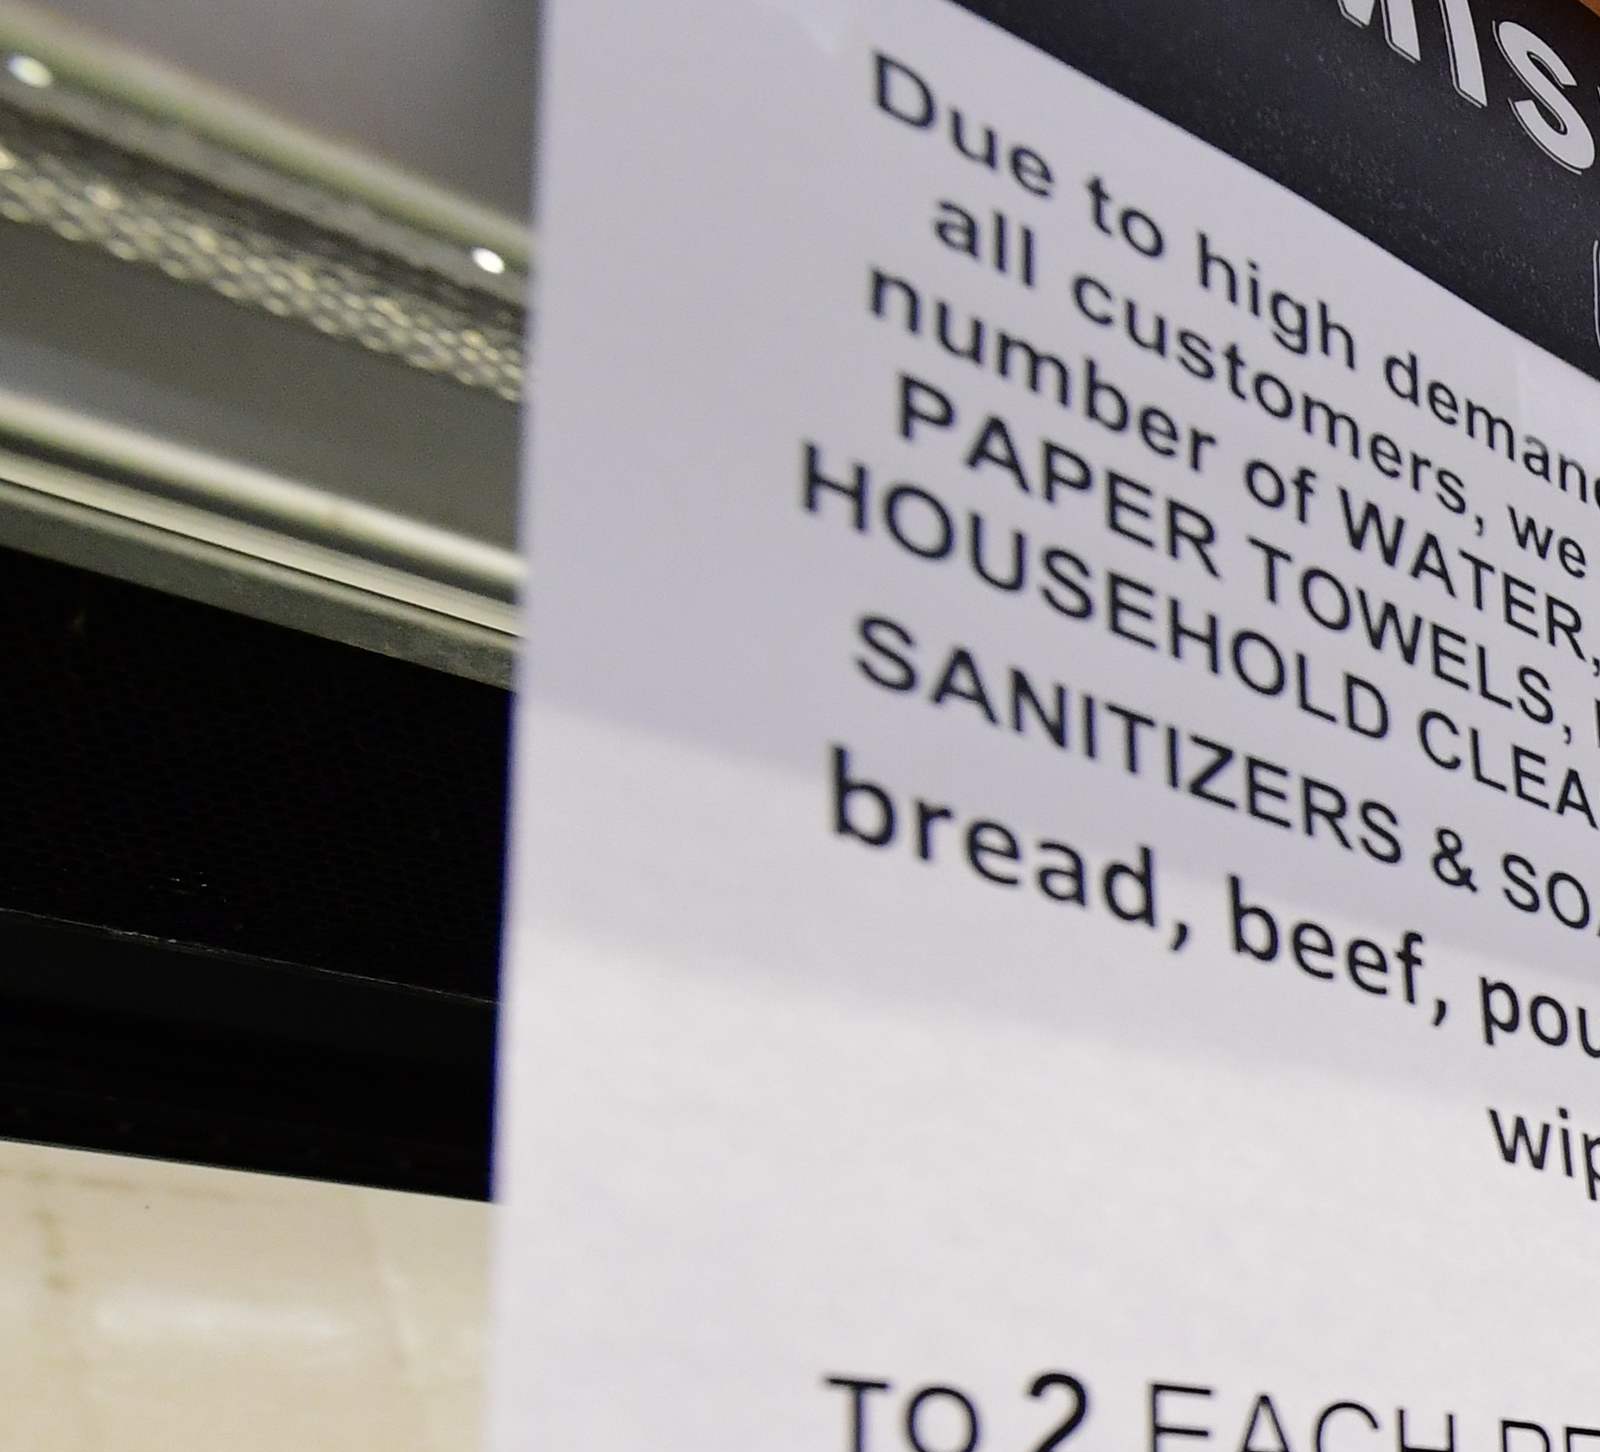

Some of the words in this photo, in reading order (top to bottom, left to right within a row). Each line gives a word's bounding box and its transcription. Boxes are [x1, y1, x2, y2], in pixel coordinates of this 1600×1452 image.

[872, 50, 1054, 197] Due
[1083, 174, 1165, 258] to
[1196, 231, 1357, 371] high
[869, 266, 1217, 470] number
[1245, 457, 1319, 524] of
[932, 197, 1036, 287] all
[1073, 273, 1488, 535] customers,
[1507, 504, 1588, 578] we
[800, 441, 1390, 740] HOUSEHOLD
[899, 374, 1224, 580] PAPER
[1249, 538, 1572, 743] TOWELS,
[829, 741, 1189, 952] bread,
[1227, 873, 1449, 1027] beef,
[855, 612, 1403, 865] SANITIZERS
[1431, 828, 1477, 894] &
